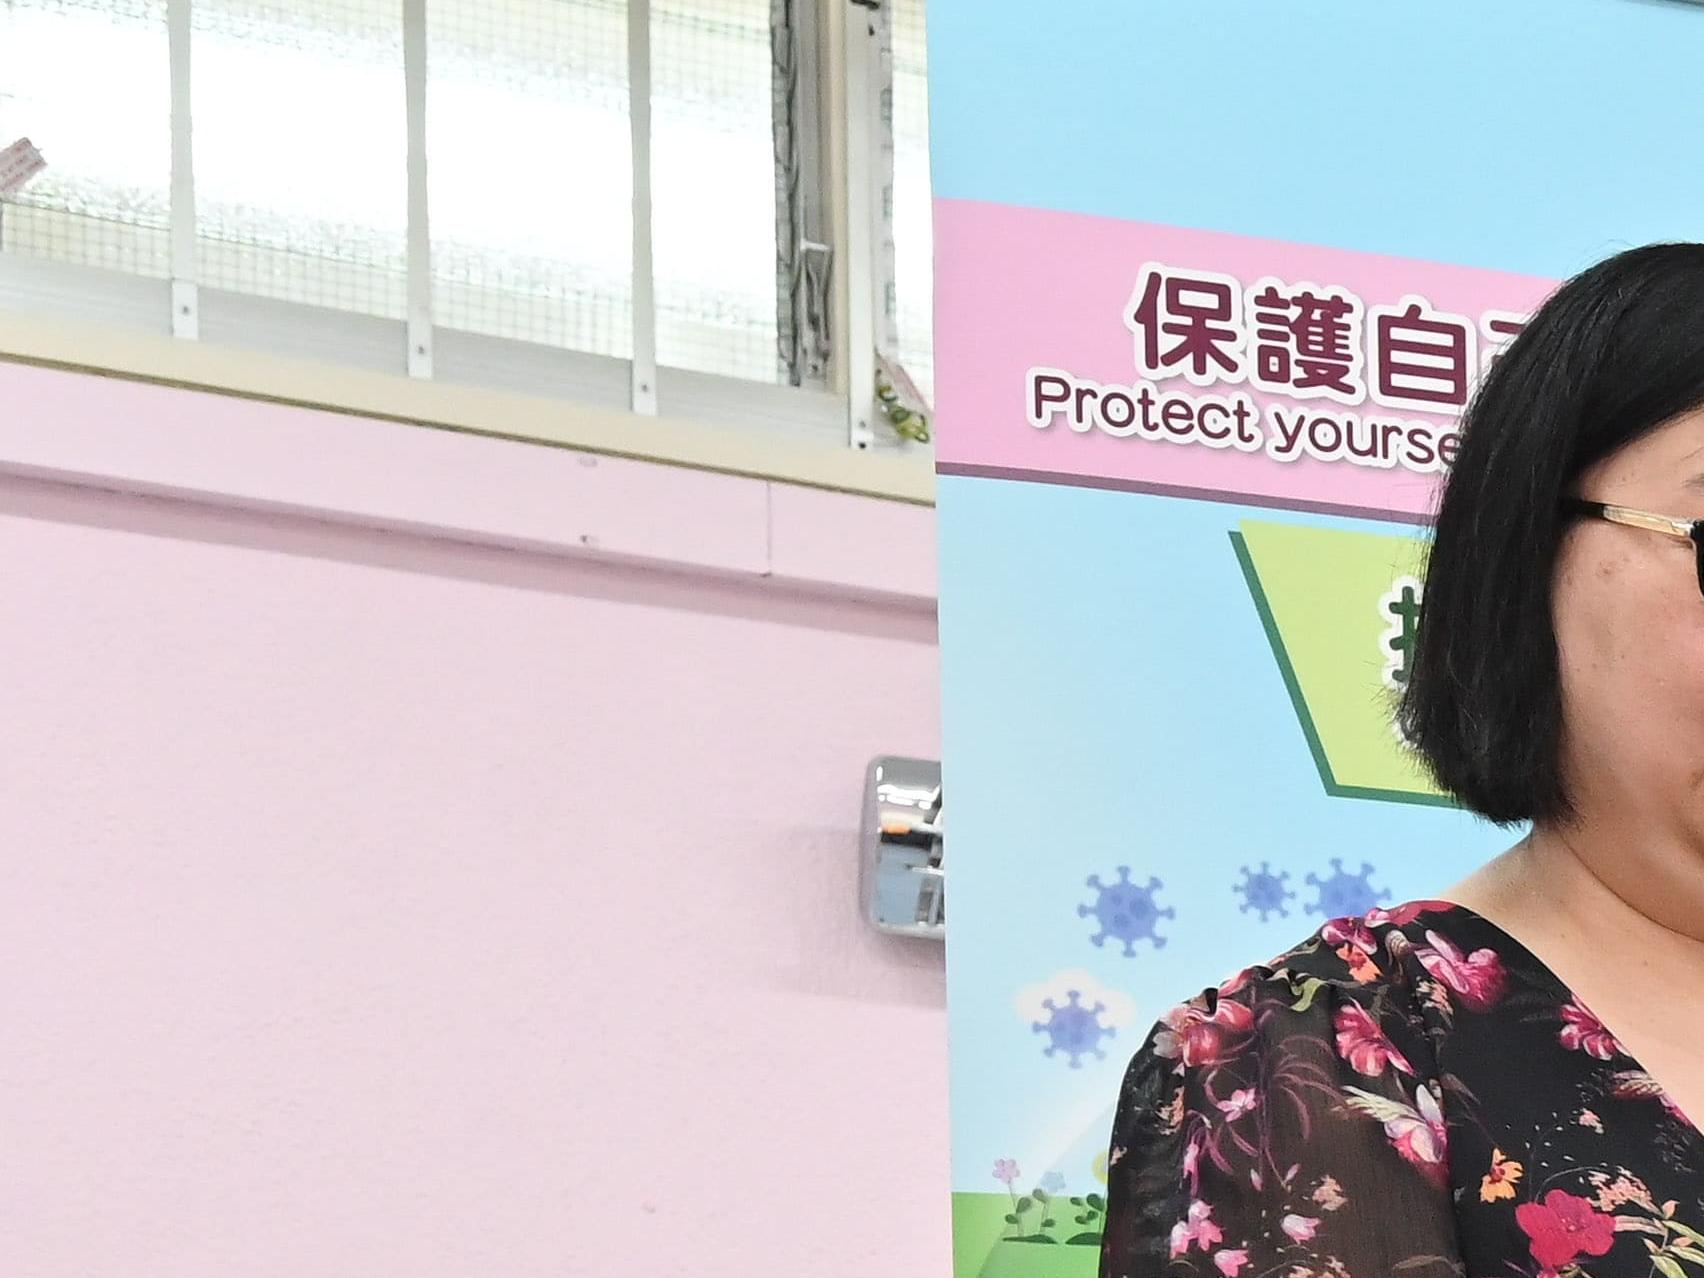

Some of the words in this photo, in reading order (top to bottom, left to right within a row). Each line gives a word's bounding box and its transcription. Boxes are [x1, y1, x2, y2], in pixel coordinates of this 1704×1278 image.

[1134, 271, 1526, 407] 保護自
[1034, 375, 1255, 443] Protect
[1273, 411, 1461, 466] yourse
